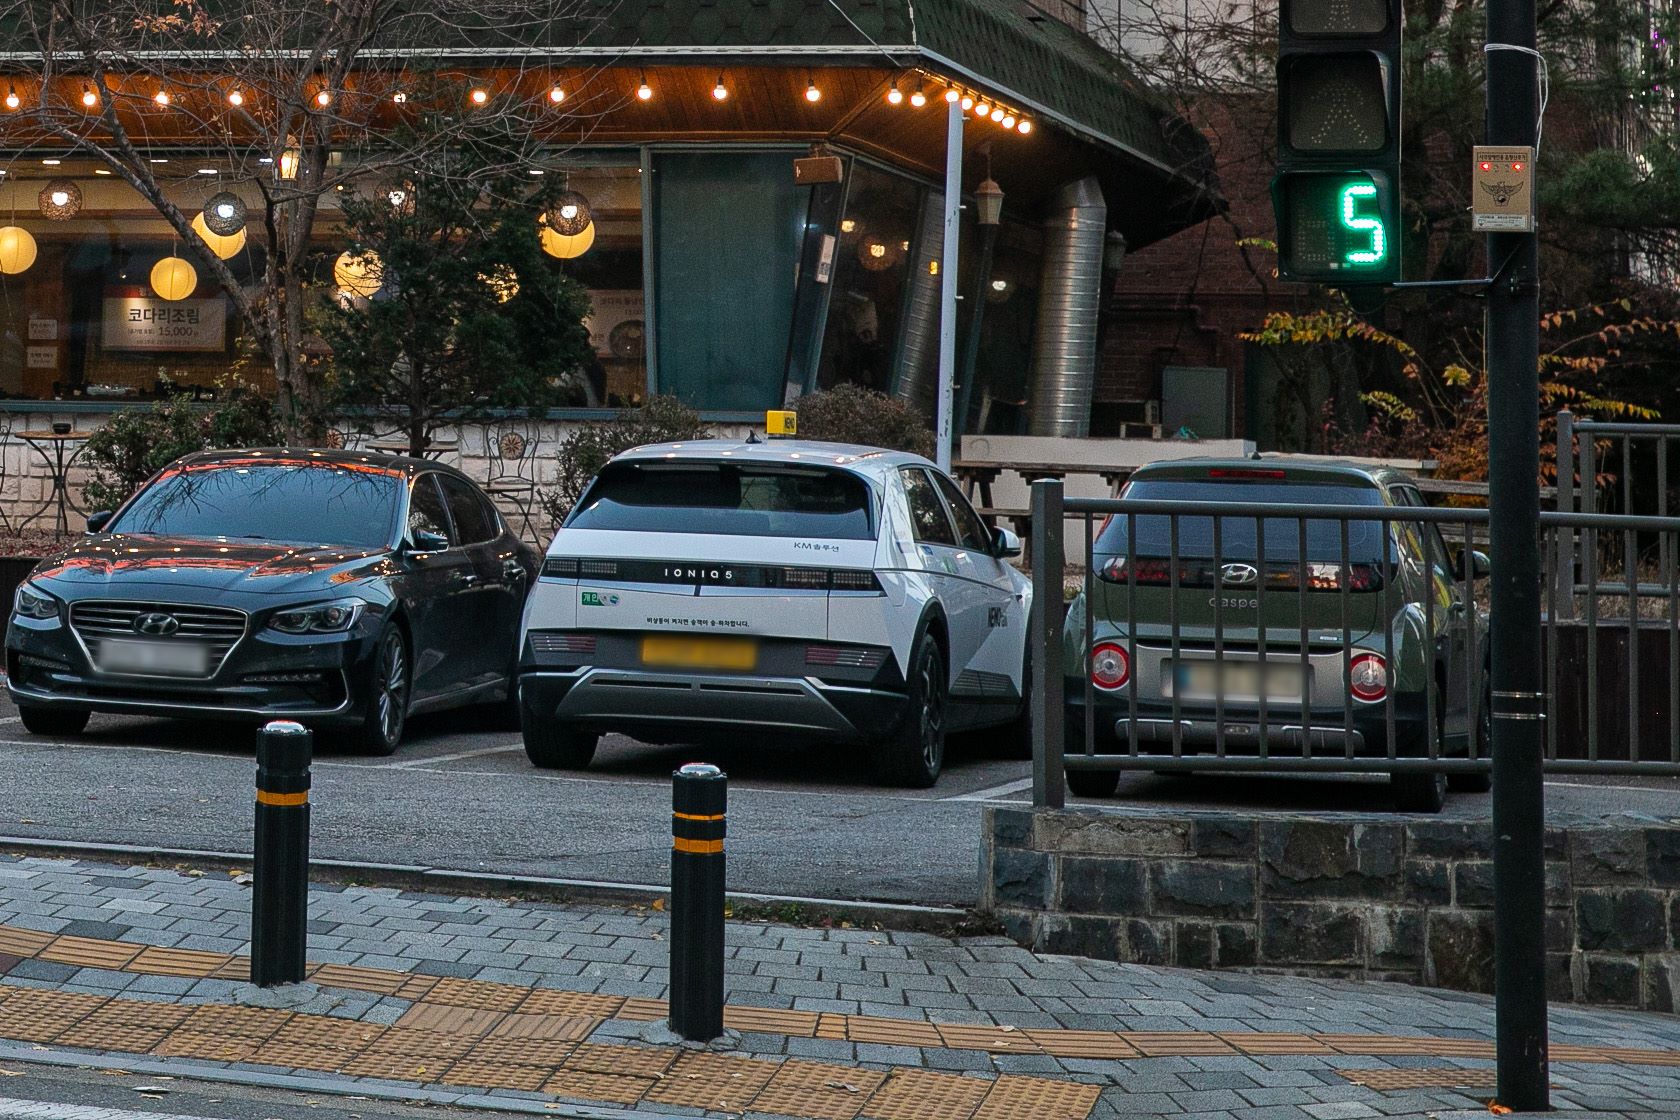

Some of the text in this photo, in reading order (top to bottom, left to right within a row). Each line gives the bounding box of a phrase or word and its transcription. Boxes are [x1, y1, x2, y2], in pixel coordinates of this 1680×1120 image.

[1341, 184, 1386, 264] 5
[128, 307, 200, 324] 코다리조림
[664, 568, 733, 579] IONIQ 5
[1208, 597, 1260, 610] caspe
